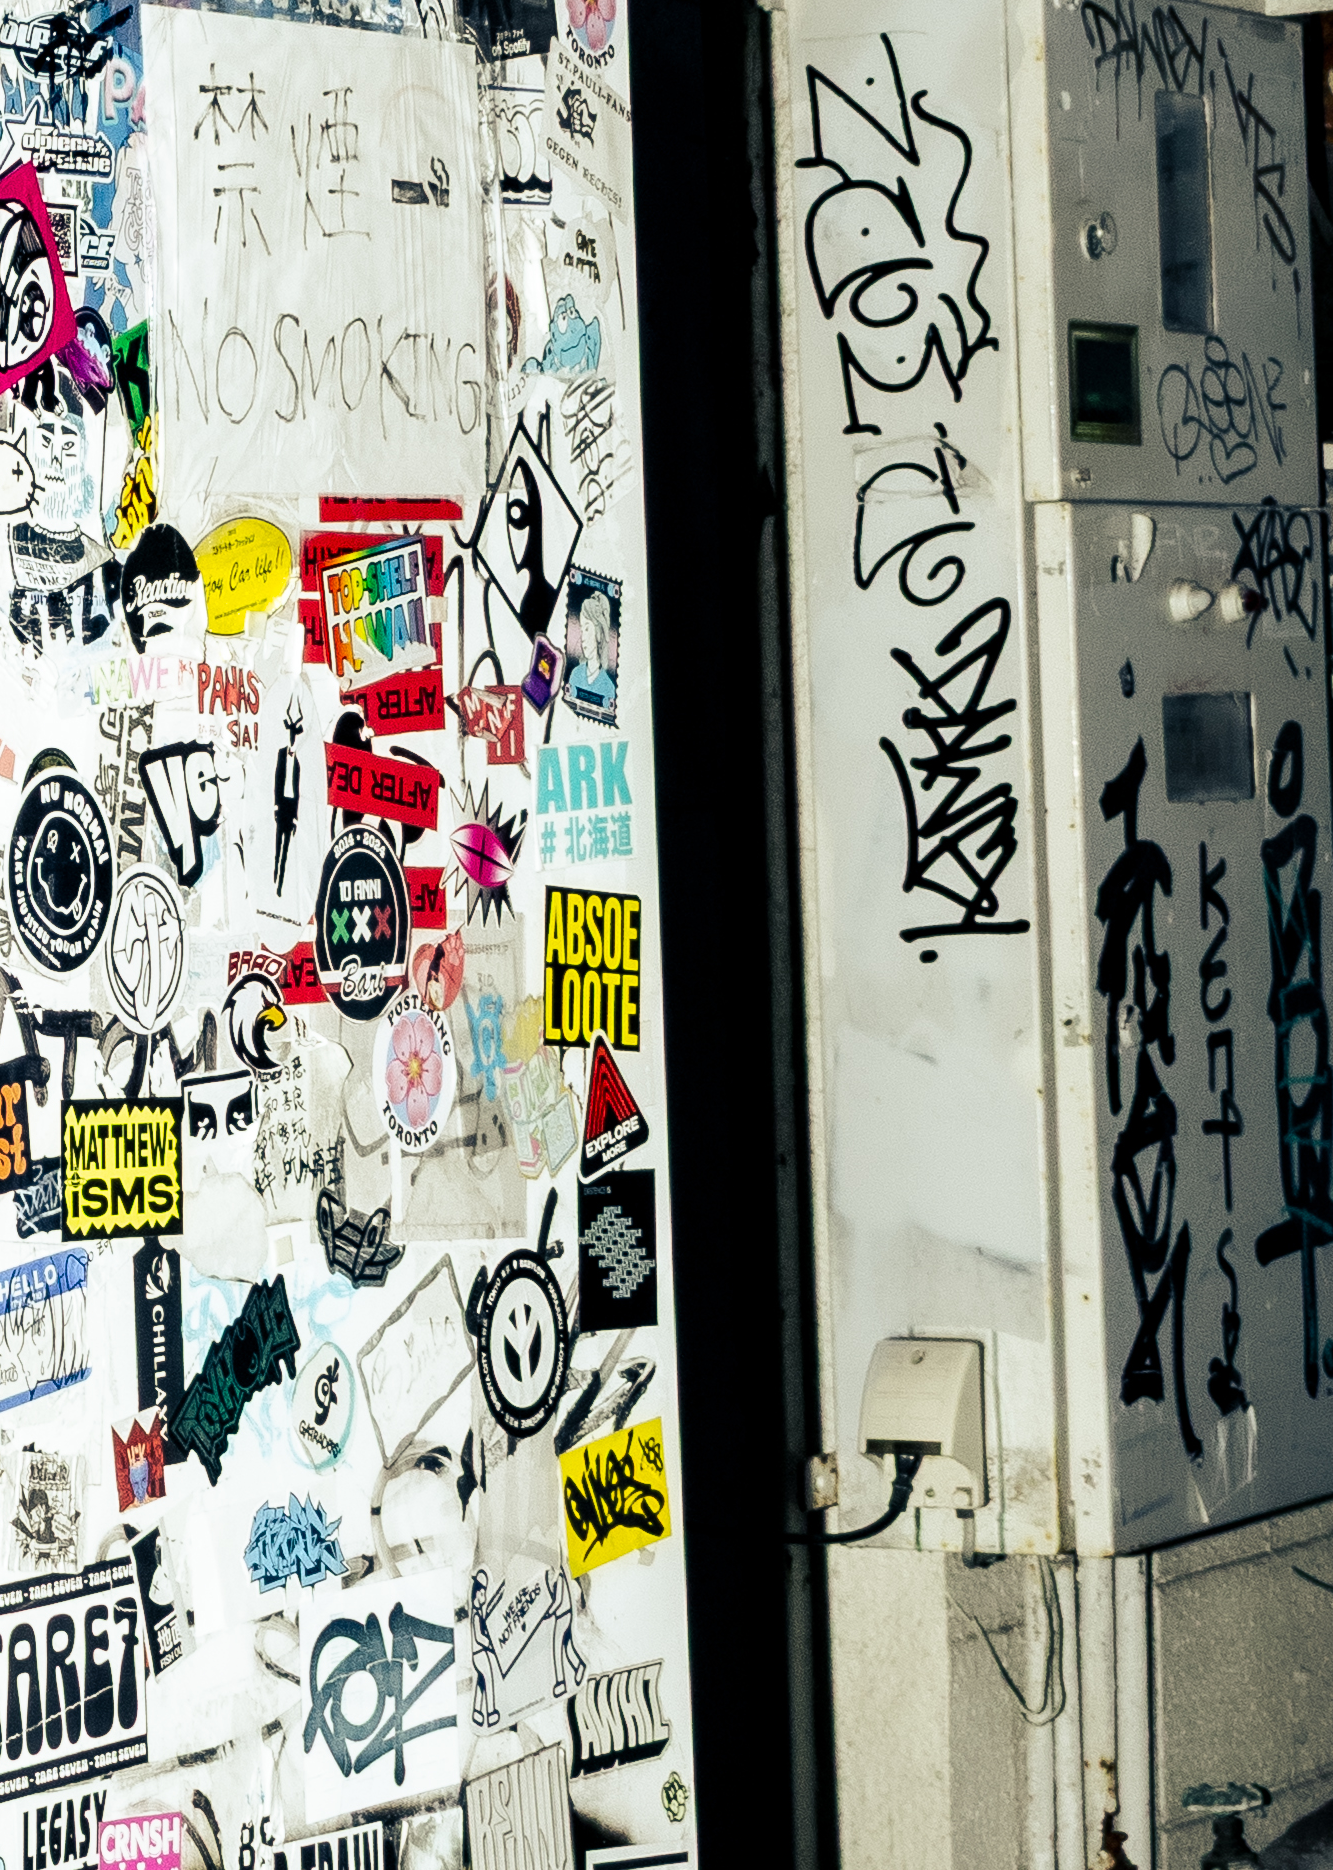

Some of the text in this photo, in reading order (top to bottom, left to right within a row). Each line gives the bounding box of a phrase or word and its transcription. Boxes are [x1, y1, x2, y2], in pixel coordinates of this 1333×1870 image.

[566, 28, 615, 70] TORONTO
[546, 136, 579, 171] GEGEN
[168, 298, 483, 442] NO SMOKING
[327, 550, 420, 616] TOP-SHELF
[537, 740, 633, 815] ARK
[40, 781, 109, 866] NU NORMAL
[564, 811, 633, 864] 北海道
[353, 878, 382, 901] ANNI
[545, 890, 641, 970] ABSOE
[339, 955, 386, 1001] Bari
[388, 994, 451, 1056] POSTERING
[545, 967, 640, 1047] LOOTE
[383, 1099, 438, 1148] TORONTO
[585, 1115, 641, 1158] EXPLORE
[602, 1141, 627, 1164] MORE
[100, 1816, 181, 1864] CRNSH
